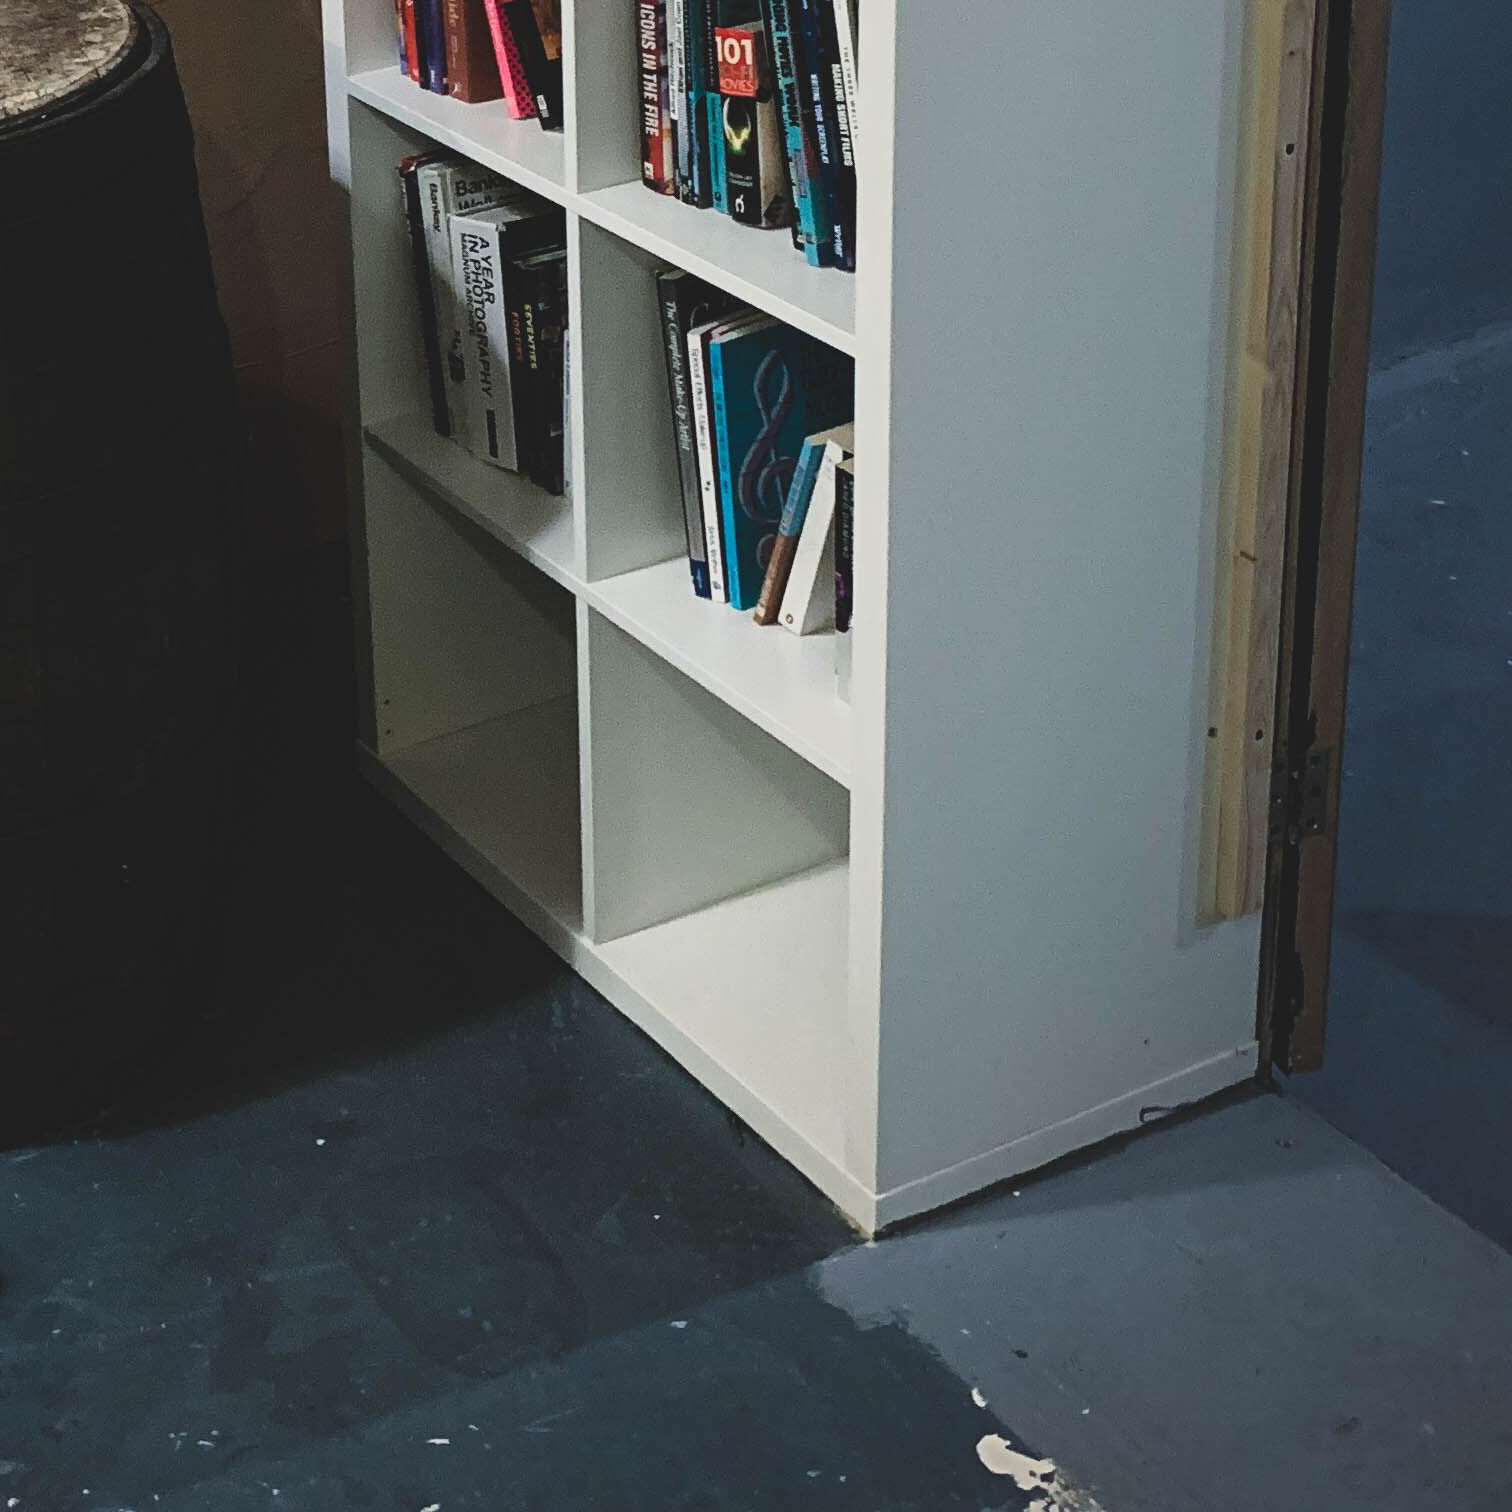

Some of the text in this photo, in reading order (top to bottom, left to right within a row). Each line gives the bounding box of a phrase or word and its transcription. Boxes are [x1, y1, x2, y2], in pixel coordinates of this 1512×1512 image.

[640, 3, 659, 137] ICONS IN THE FIRE
[715, 35, 753, 65] 101
[831, 62, 854, 166] MAKING SHORT FILMS
[429, 182, 442, 234] Banksy
[832, 224, 845, 258] Writer
[461, 233, 472, 285] MAGNUM
[479, 236, 496, 305] A YEAR
[467, 233, 492, 400] IN PHOTOGRAPHY
[511, 311, 524, 361] FORTIES
[523, 303, 538, 369] SEVENTIES
[665, 300, 692, 452] The Complete Make-Up Artist
